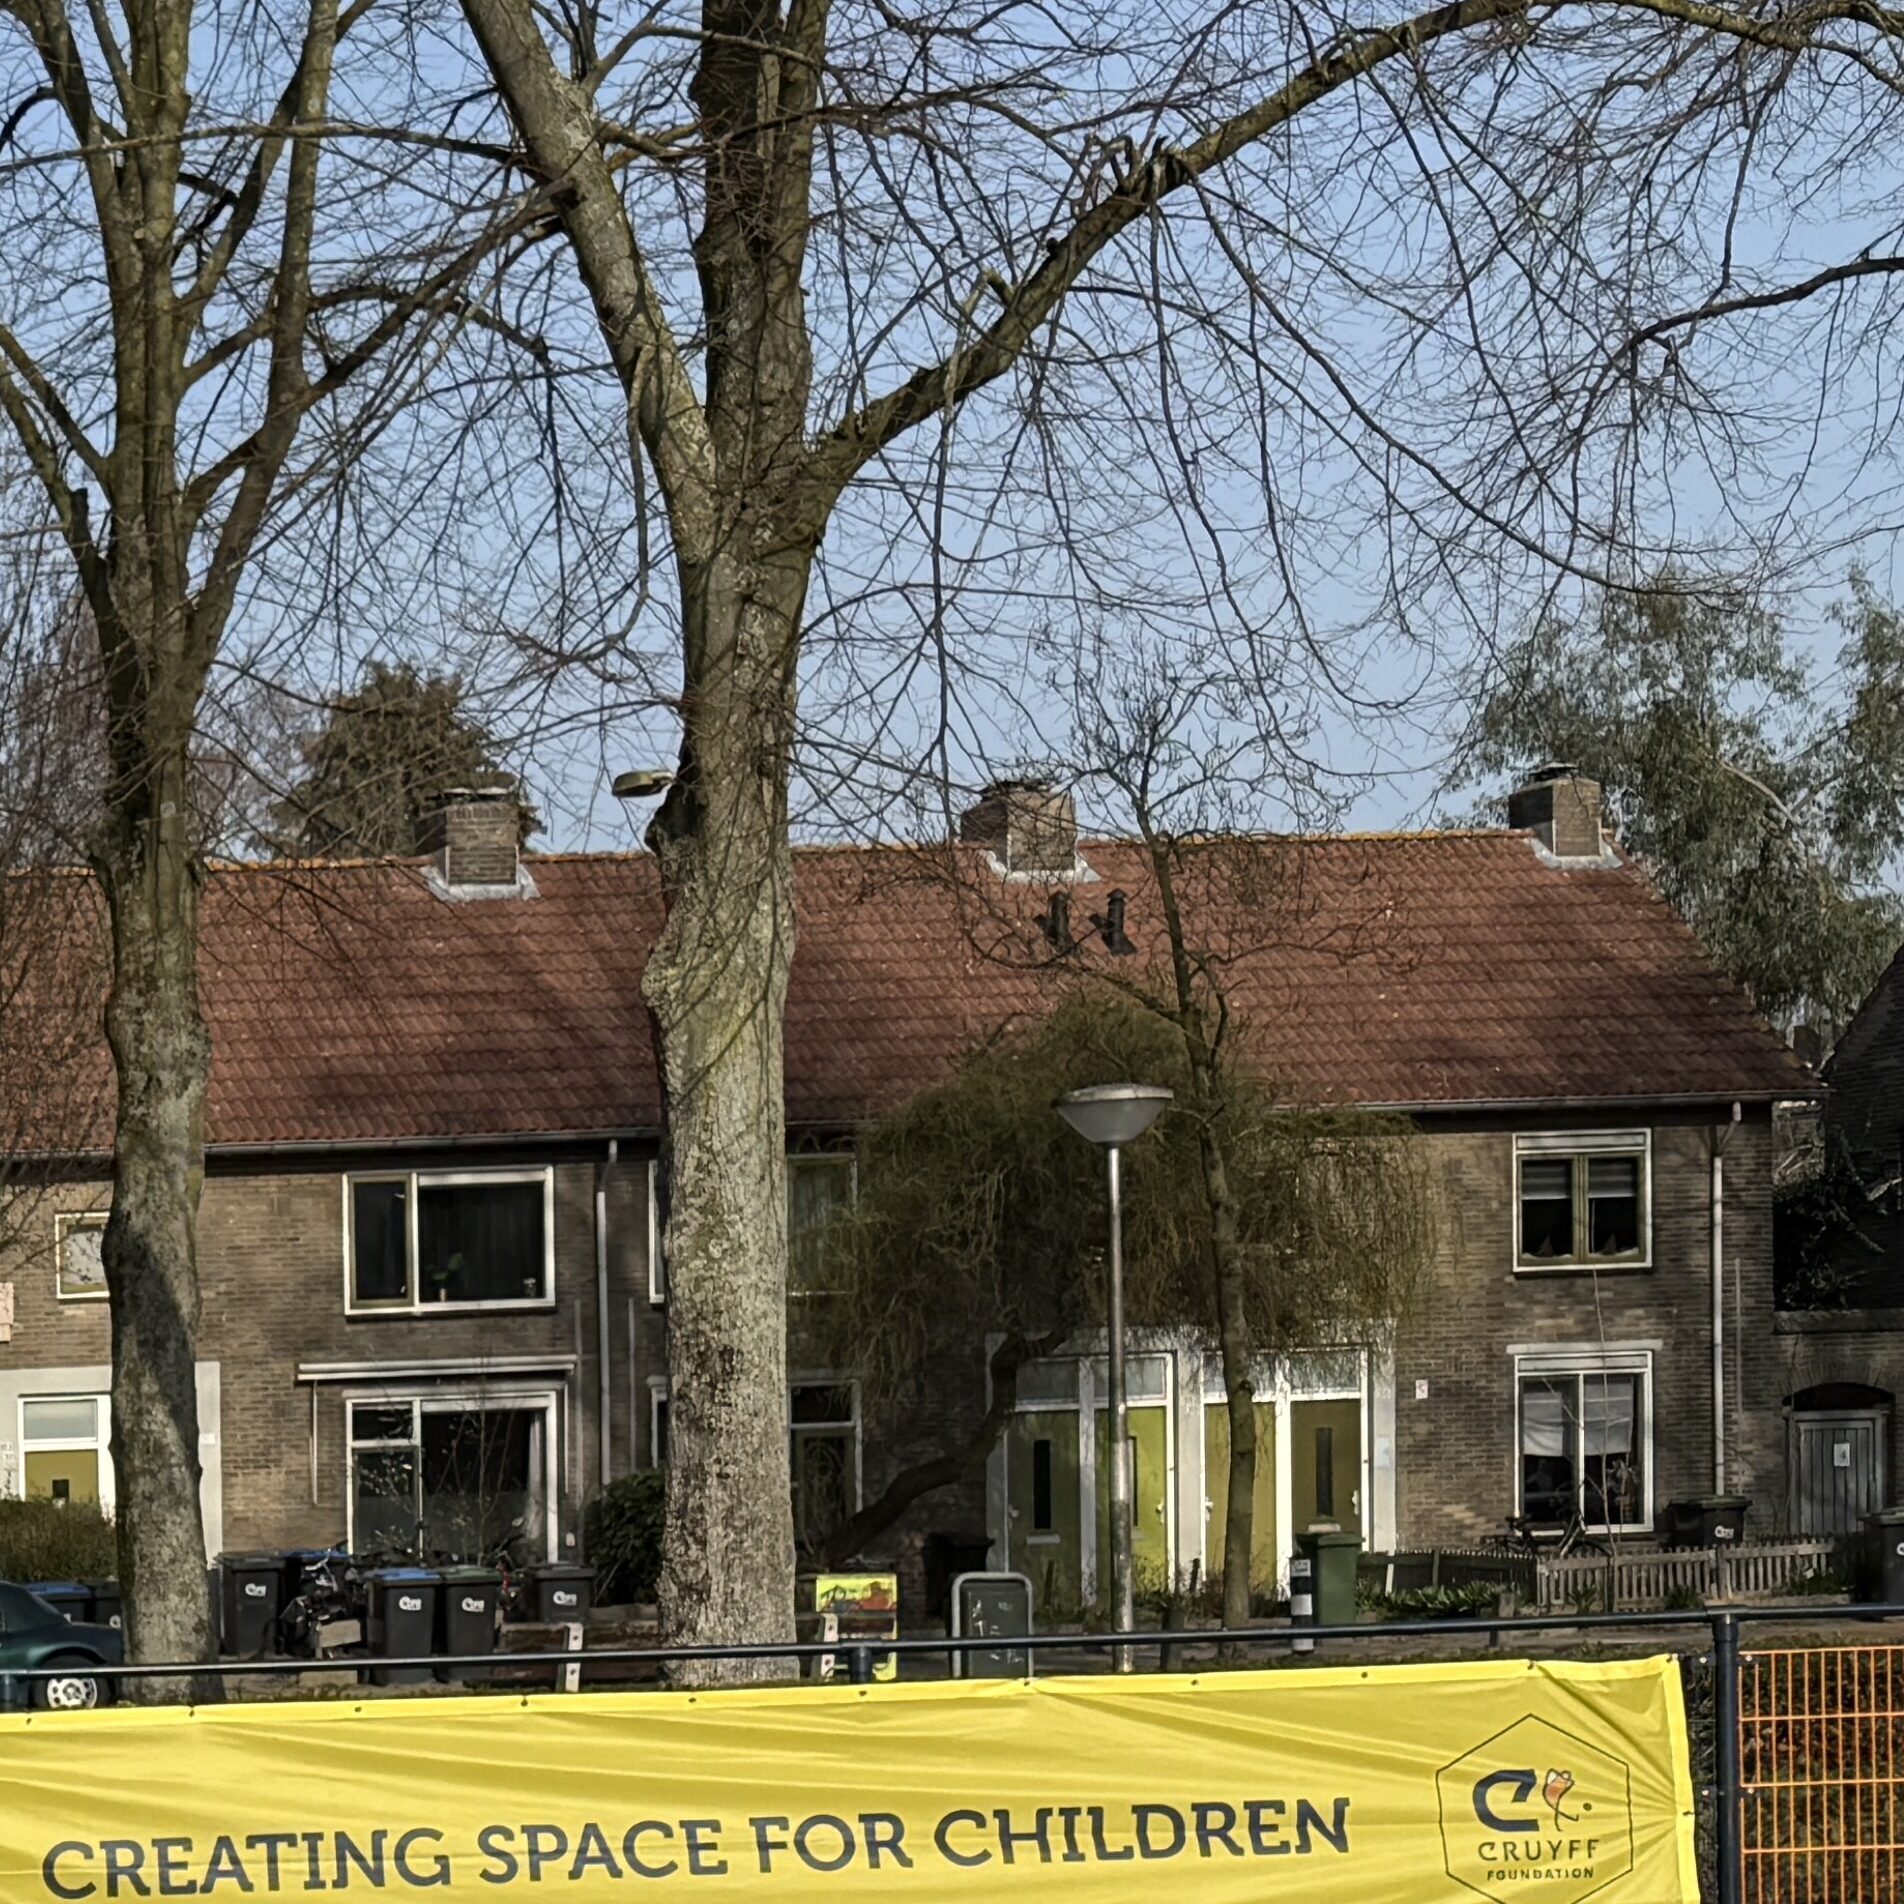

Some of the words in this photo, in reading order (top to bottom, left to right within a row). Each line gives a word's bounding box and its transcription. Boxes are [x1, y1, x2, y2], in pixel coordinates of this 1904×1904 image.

[41, 1827, 452, 1901] CREATING
[478, 1818, 730, 1884] SPACE
[748, 1813, 914, 1874] FOR
[933, 1796, 1351, 1867] CHILDREN
[1477, 1838, 1601, 1862] CRUYFF
[1486, 1866, 1596, 1882] FOUNDATION
